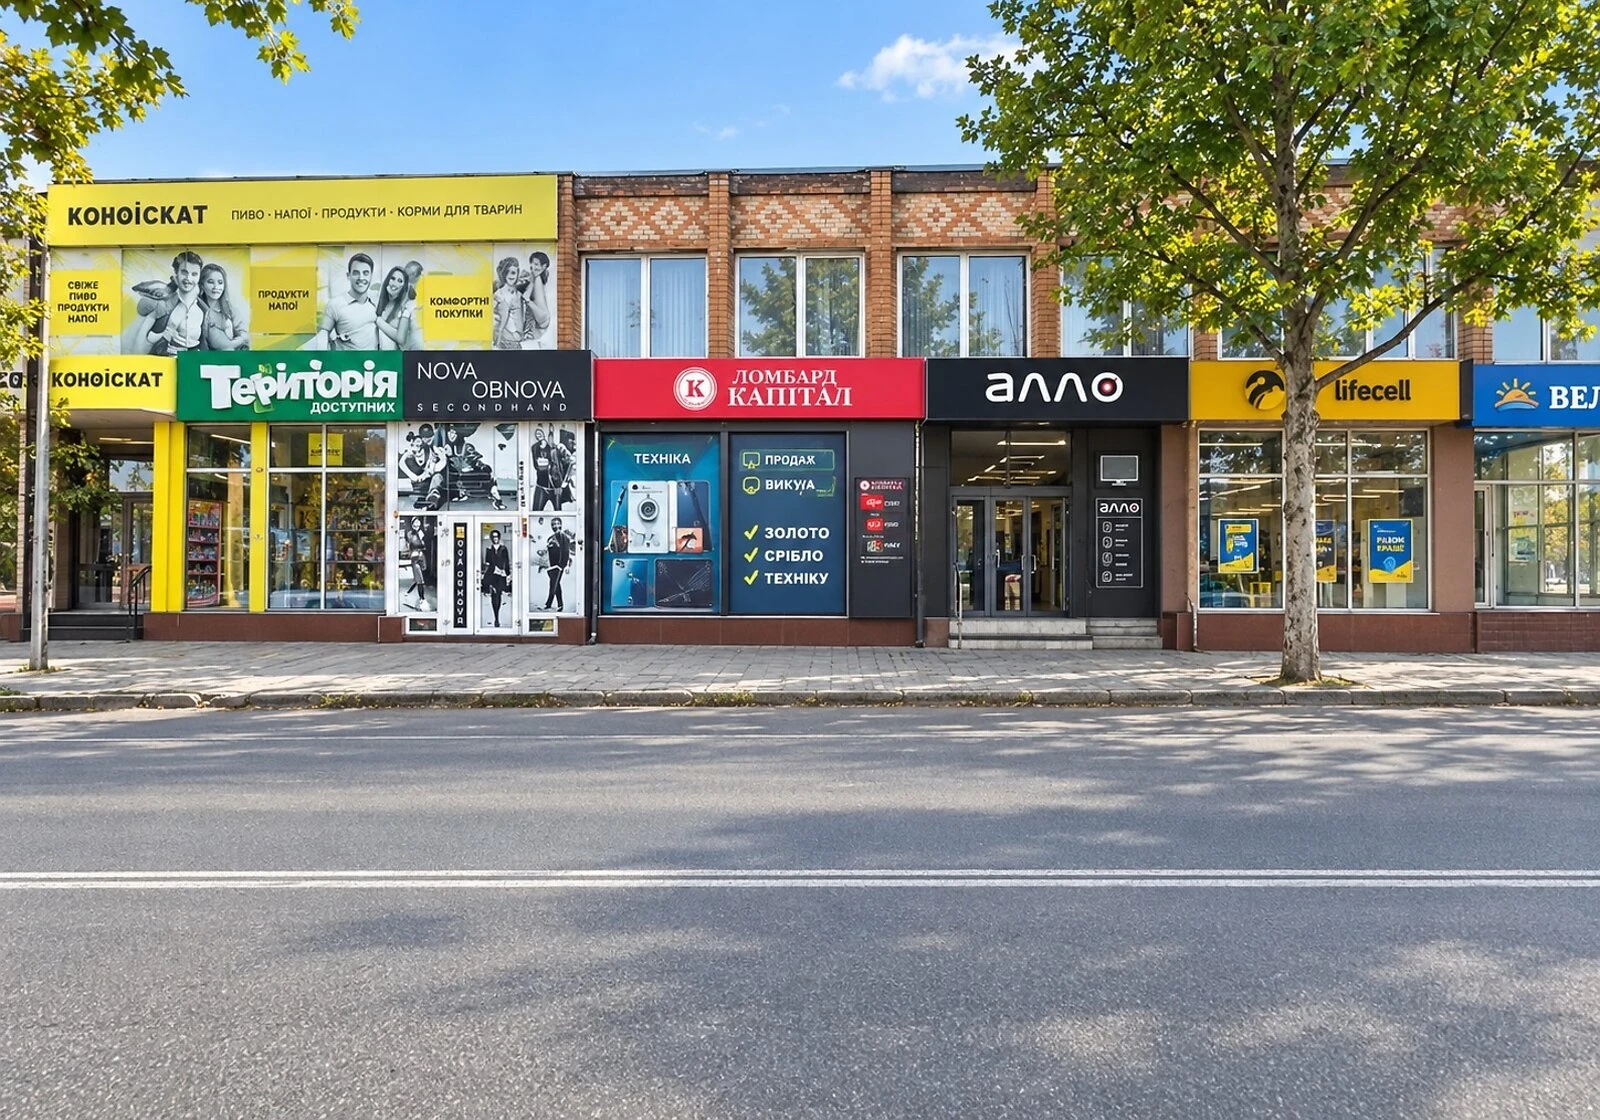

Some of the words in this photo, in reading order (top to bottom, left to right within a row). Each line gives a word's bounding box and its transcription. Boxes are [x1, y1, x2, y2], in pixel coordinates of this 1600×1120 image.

[231, 210, 265, 221] ПИВО
[274, 207, 312, 220] НАПОЇ
[321, 207, 386, 220] ПРОДУКТИ
[397, 205, 441, 217] КОРМИ
[444, 205, 470, 218] ДЛЯ
[473, 204, 523, 216] ТВАРИН
[67, 281, 99, 290] СВІЖЕ
[69, 292, 97, 300] ПИВО
[258, 290, 310, 299] ПРОДУКТИ
[57, 303, 110, 312] ПРОДУКТИ
[430, 297, 490, 306] КОМФОРТНІ
[435, 309, 483, 318] ПОКУПКИ
[417, 362, 478, 380] NOVA
[732, 369, 838, 387] ЛОМБАРД
[472, 380, 566, 399] OBNOVA
[1334, 379, 1412, 401] lifecell
[727, 387, 854, 407] КАПІТАЛ
[310, 402, 396, 415] ДОСТУПНИХ
[633, 453, 692, 465] ТЕХНІКА
[765, 455, 816, 467] ПРОДАЖ
[764, 527, 830, 539] ЗОЛОТО
[764, 549, 824, 562] СРІБЛО
[764, 572, 830, 585] ТЕХНІКУ
